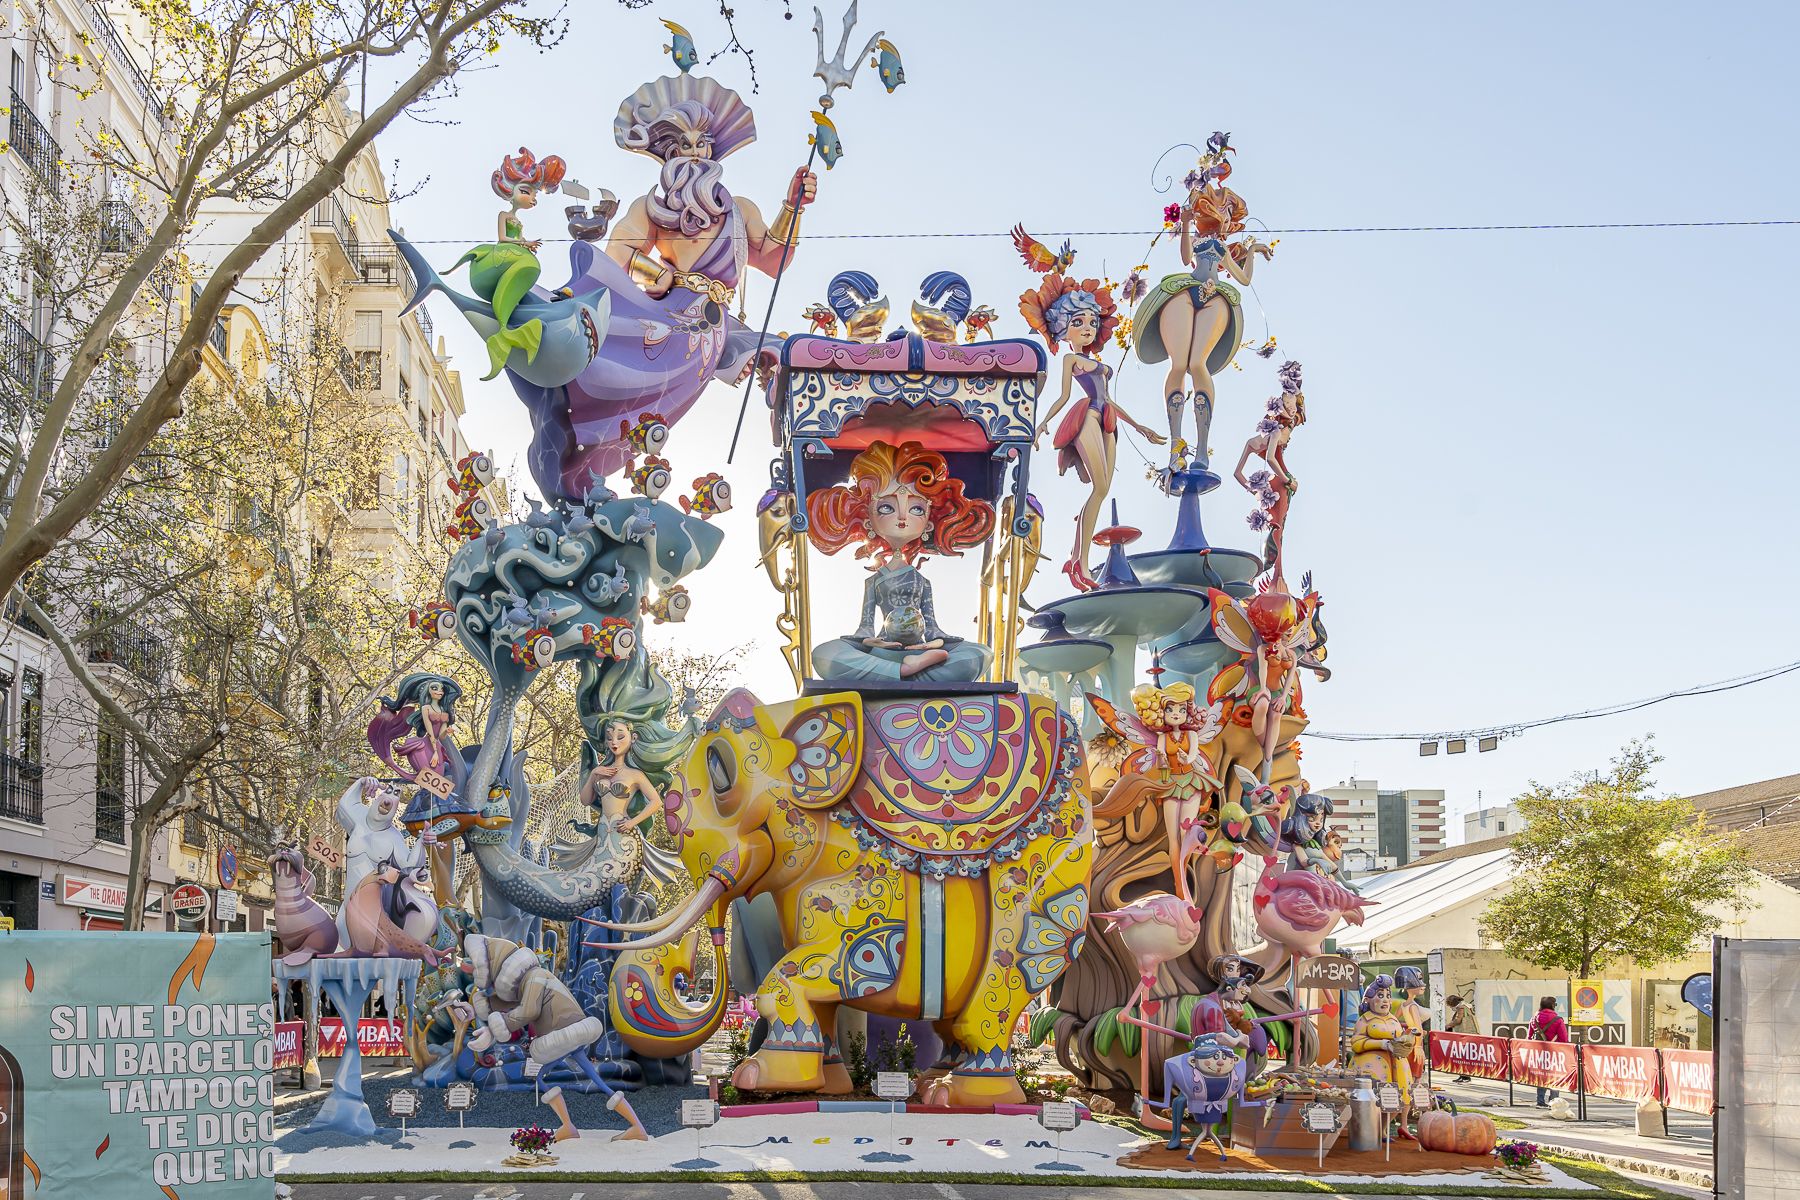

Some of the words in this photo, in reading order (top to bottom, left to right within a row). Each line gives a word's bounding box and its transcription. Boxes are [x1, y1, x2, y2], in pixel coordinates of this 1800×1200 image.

[421, 771, 450, 794] S.O.S
[312, 841, 340, 863] S.O.S
[90, 887, 100, 900] THE
[102, 888, 126, 907] ORANG
[174, 897, 205, 909] ORANGE
[1302, 962, 1355, 983] AM-BAR
[50, 1005, 87, 1040] SI
[97, 1004, 155, 1039] ME
[163, 1003, 273, 1037] PONES
[274, 1030, 296, 1052] MBAR
[1450, 1040, 1497, 1063] AMBAR
[51, 1043, 105, 1079] UN
[114, 1029, 273, 1077] BARCELÓ
[1528, 1047, 1567, 1073] AMBAR
[1602, 1055, 1648, 1080] AMBAR
[1680, 1062, 1712, 1091] AMBAR
[102, 1074, 274, 1114] TAMPOCO
[142, 1115, 188, 1149] TE
[196, 1110, 274, 1146] DIGO
[153, 1149, 226, 1186] QUE
[233, 1145, 275, 1180] NO
